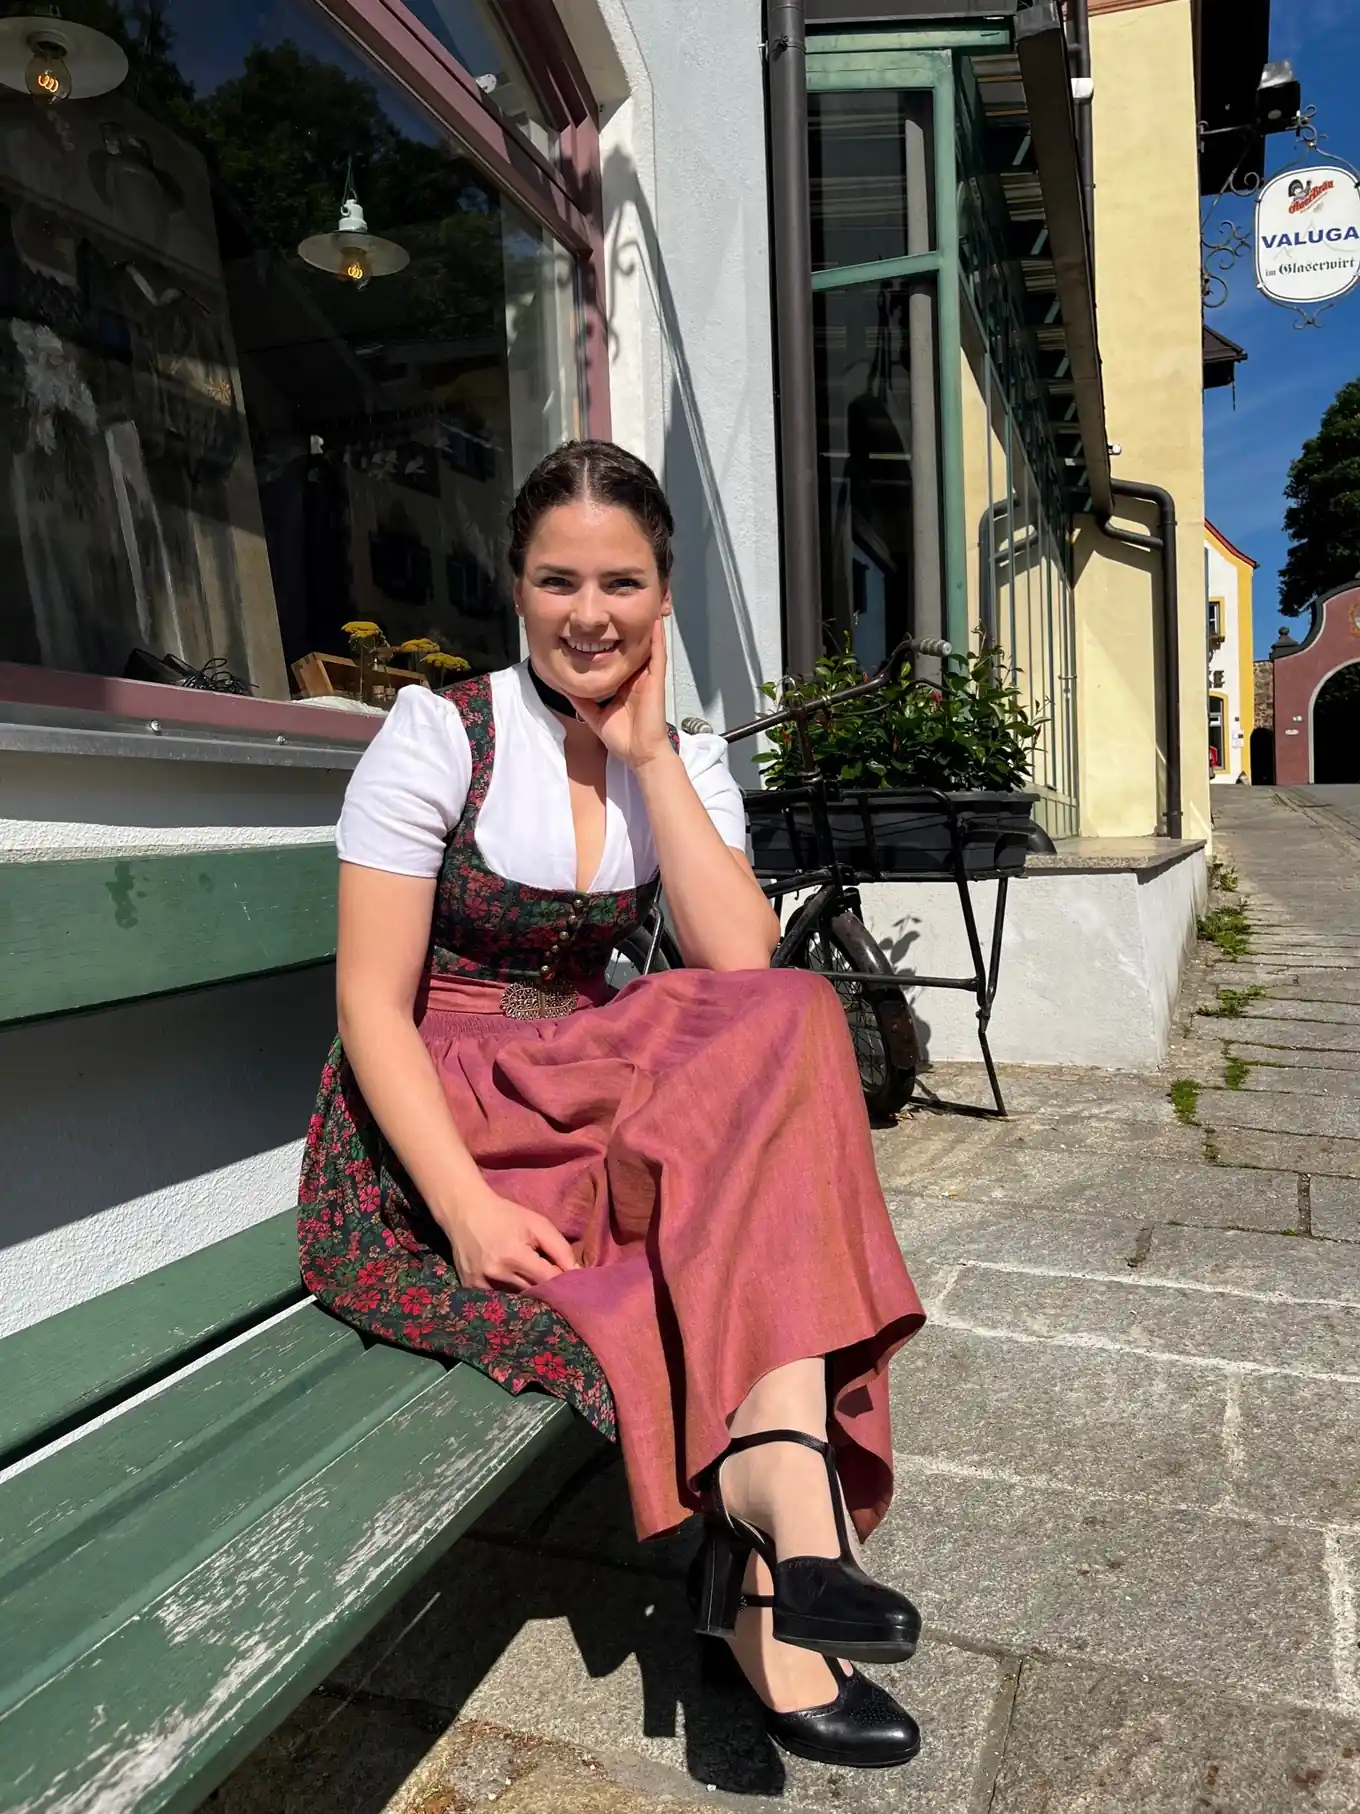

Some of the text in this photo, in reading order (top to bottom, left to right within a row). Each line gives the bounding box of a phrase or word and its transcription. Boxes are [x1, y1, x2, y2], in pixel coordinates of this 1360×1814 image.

[1261, 226, 1360, 249] VALUGA
[1265, 257, 1355, 277] im Glaserwirt
